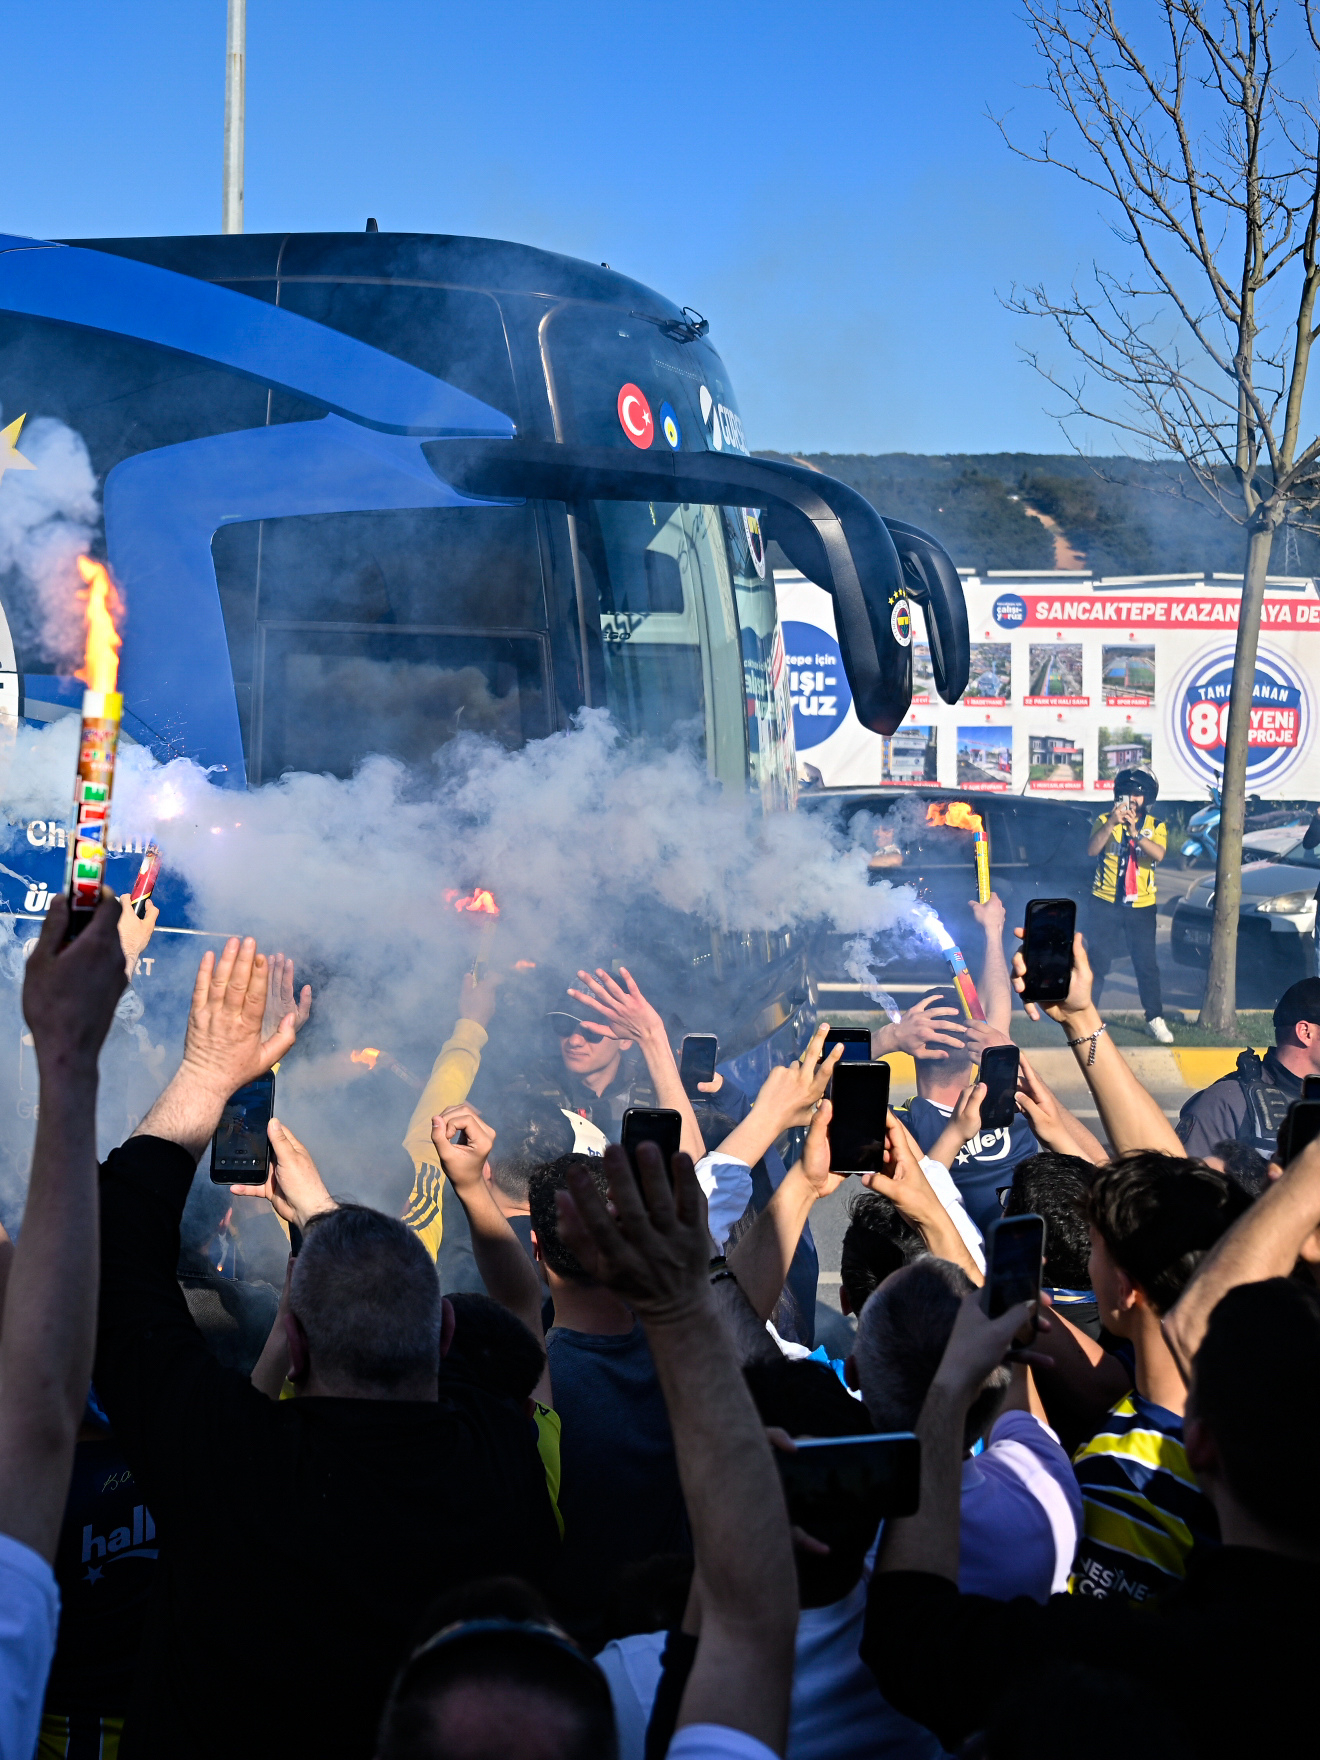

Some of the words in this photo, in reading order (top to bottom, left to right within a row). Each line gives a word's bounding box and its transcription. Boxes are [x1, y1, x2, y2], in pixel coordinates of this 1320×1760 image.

[1036, 602, 1167, 621] SANCAKTEPE
[1170, 603, 1291, 623] KAZANAYA
[786, 654, 813, 665] tepe
[815, 653, 836, 666] için
[790, 695, 837, 716] ruz
[1248, 729, 1293, 743] PROJE
